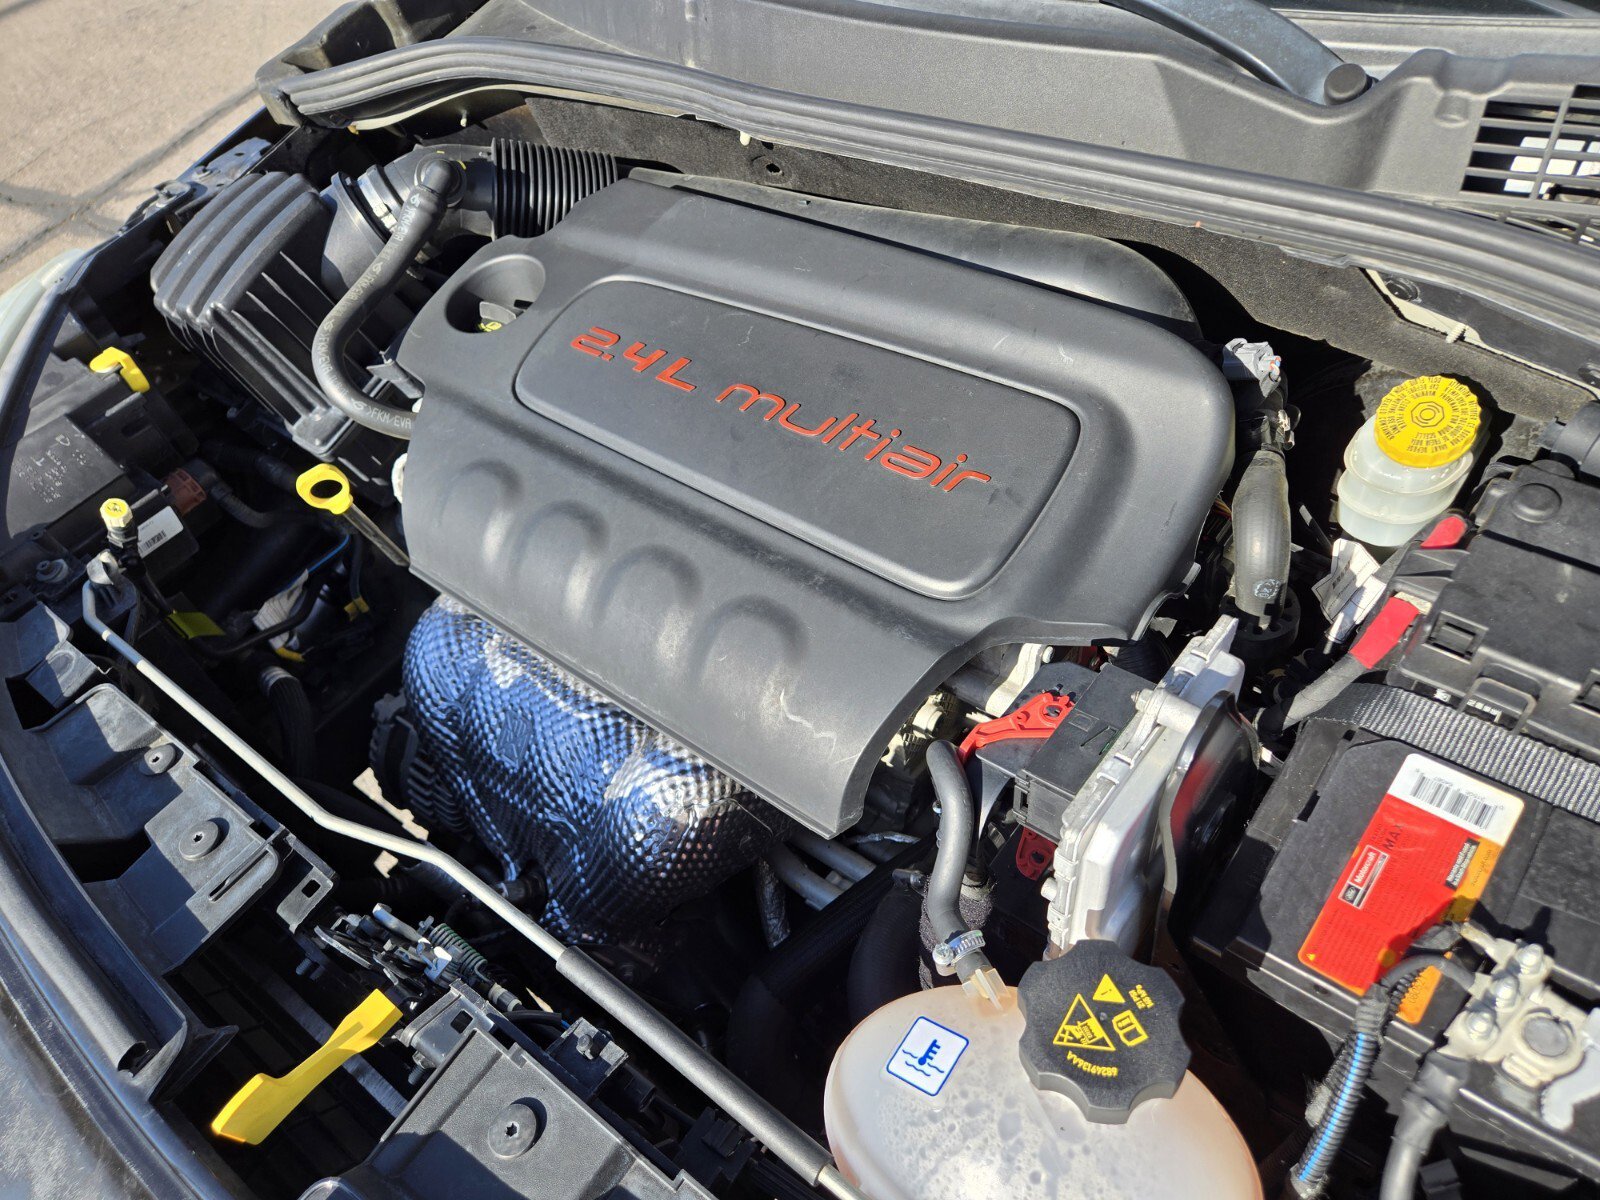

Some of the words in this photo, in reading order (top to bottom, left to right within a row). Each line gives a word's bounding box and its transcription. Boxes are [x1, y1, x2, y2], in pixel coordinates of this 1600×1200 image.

[570, 326, 697, 392] 2.4L
[715, 383, 991, 492] multiair
[1354, 851, 1376, 883] Motorcraft
